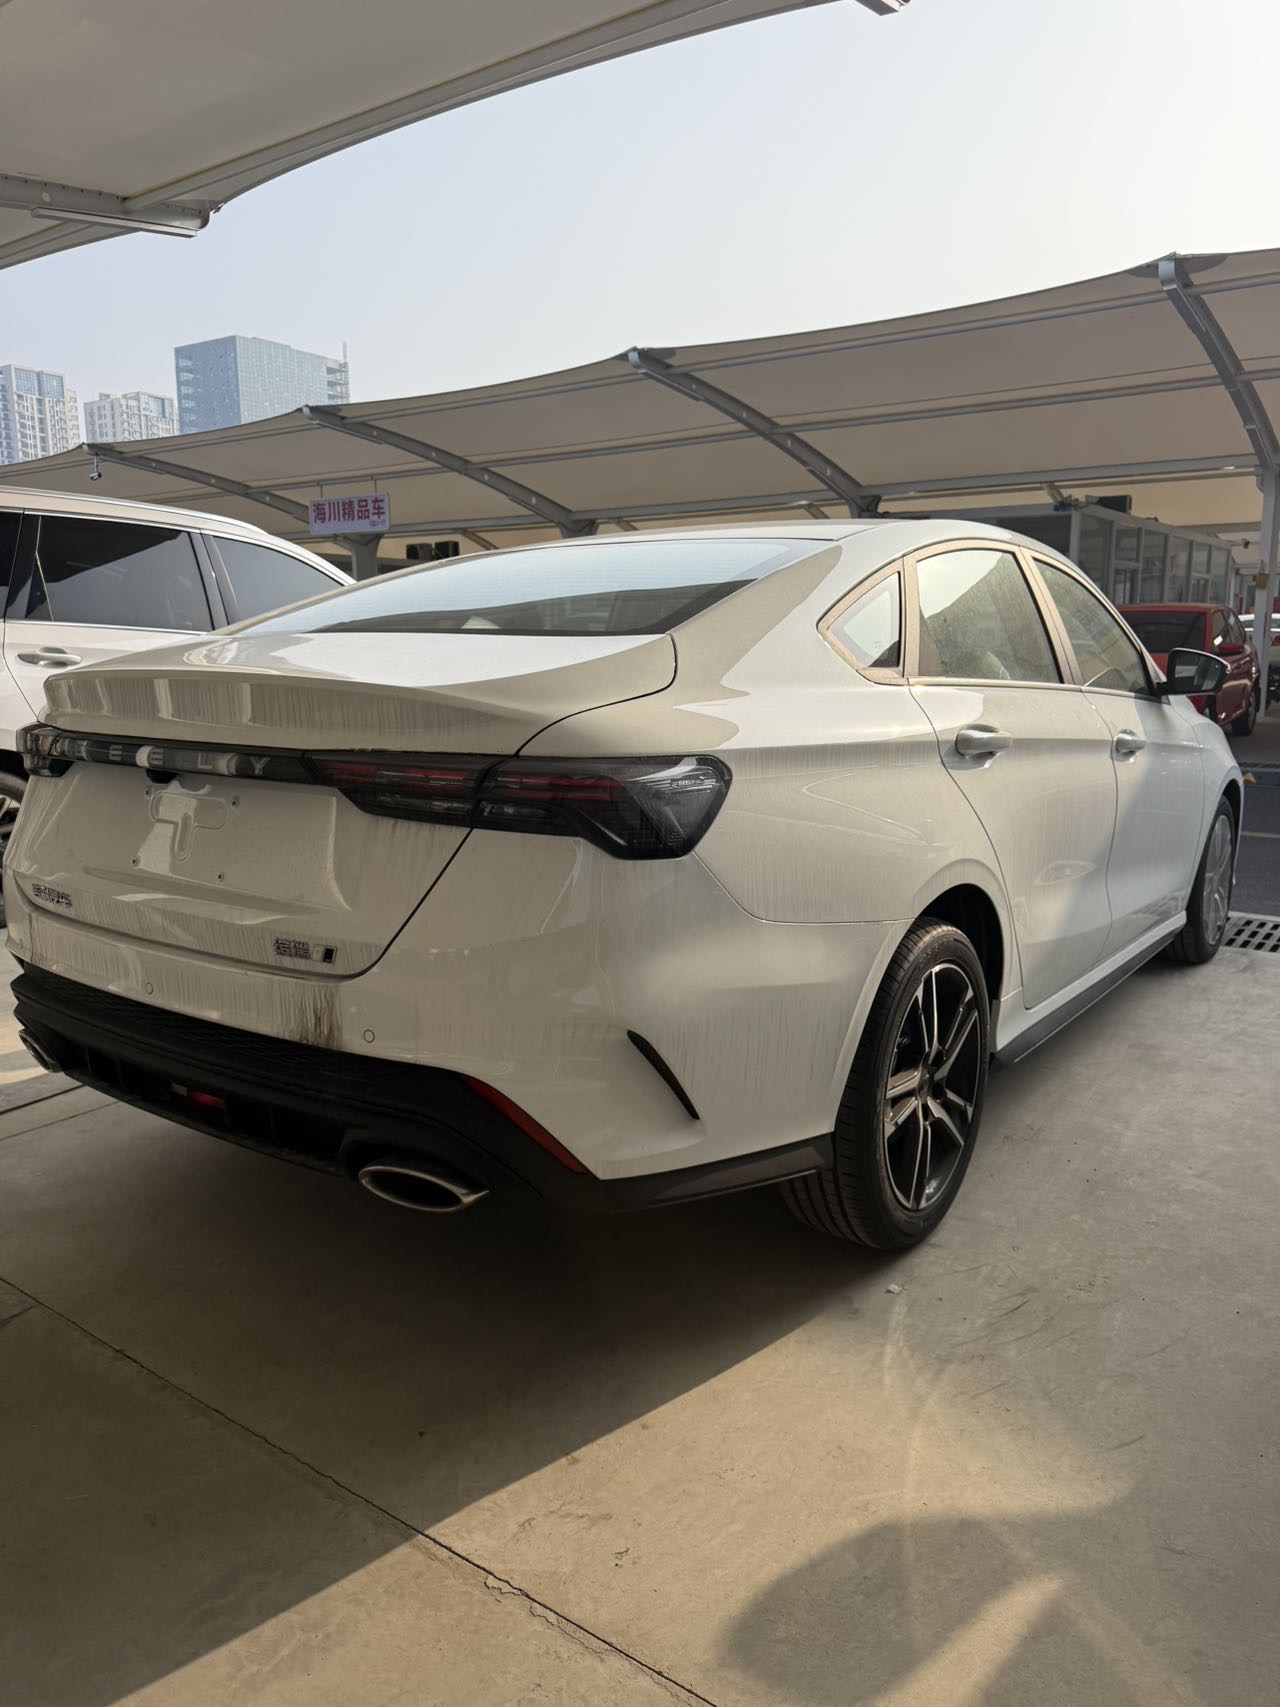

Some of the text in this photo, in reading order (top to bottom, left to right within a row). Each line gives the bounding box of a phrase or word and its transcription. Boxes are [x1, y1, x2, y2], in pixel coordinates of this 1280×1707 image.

[313, 497, 385, 524] 海川精品车
